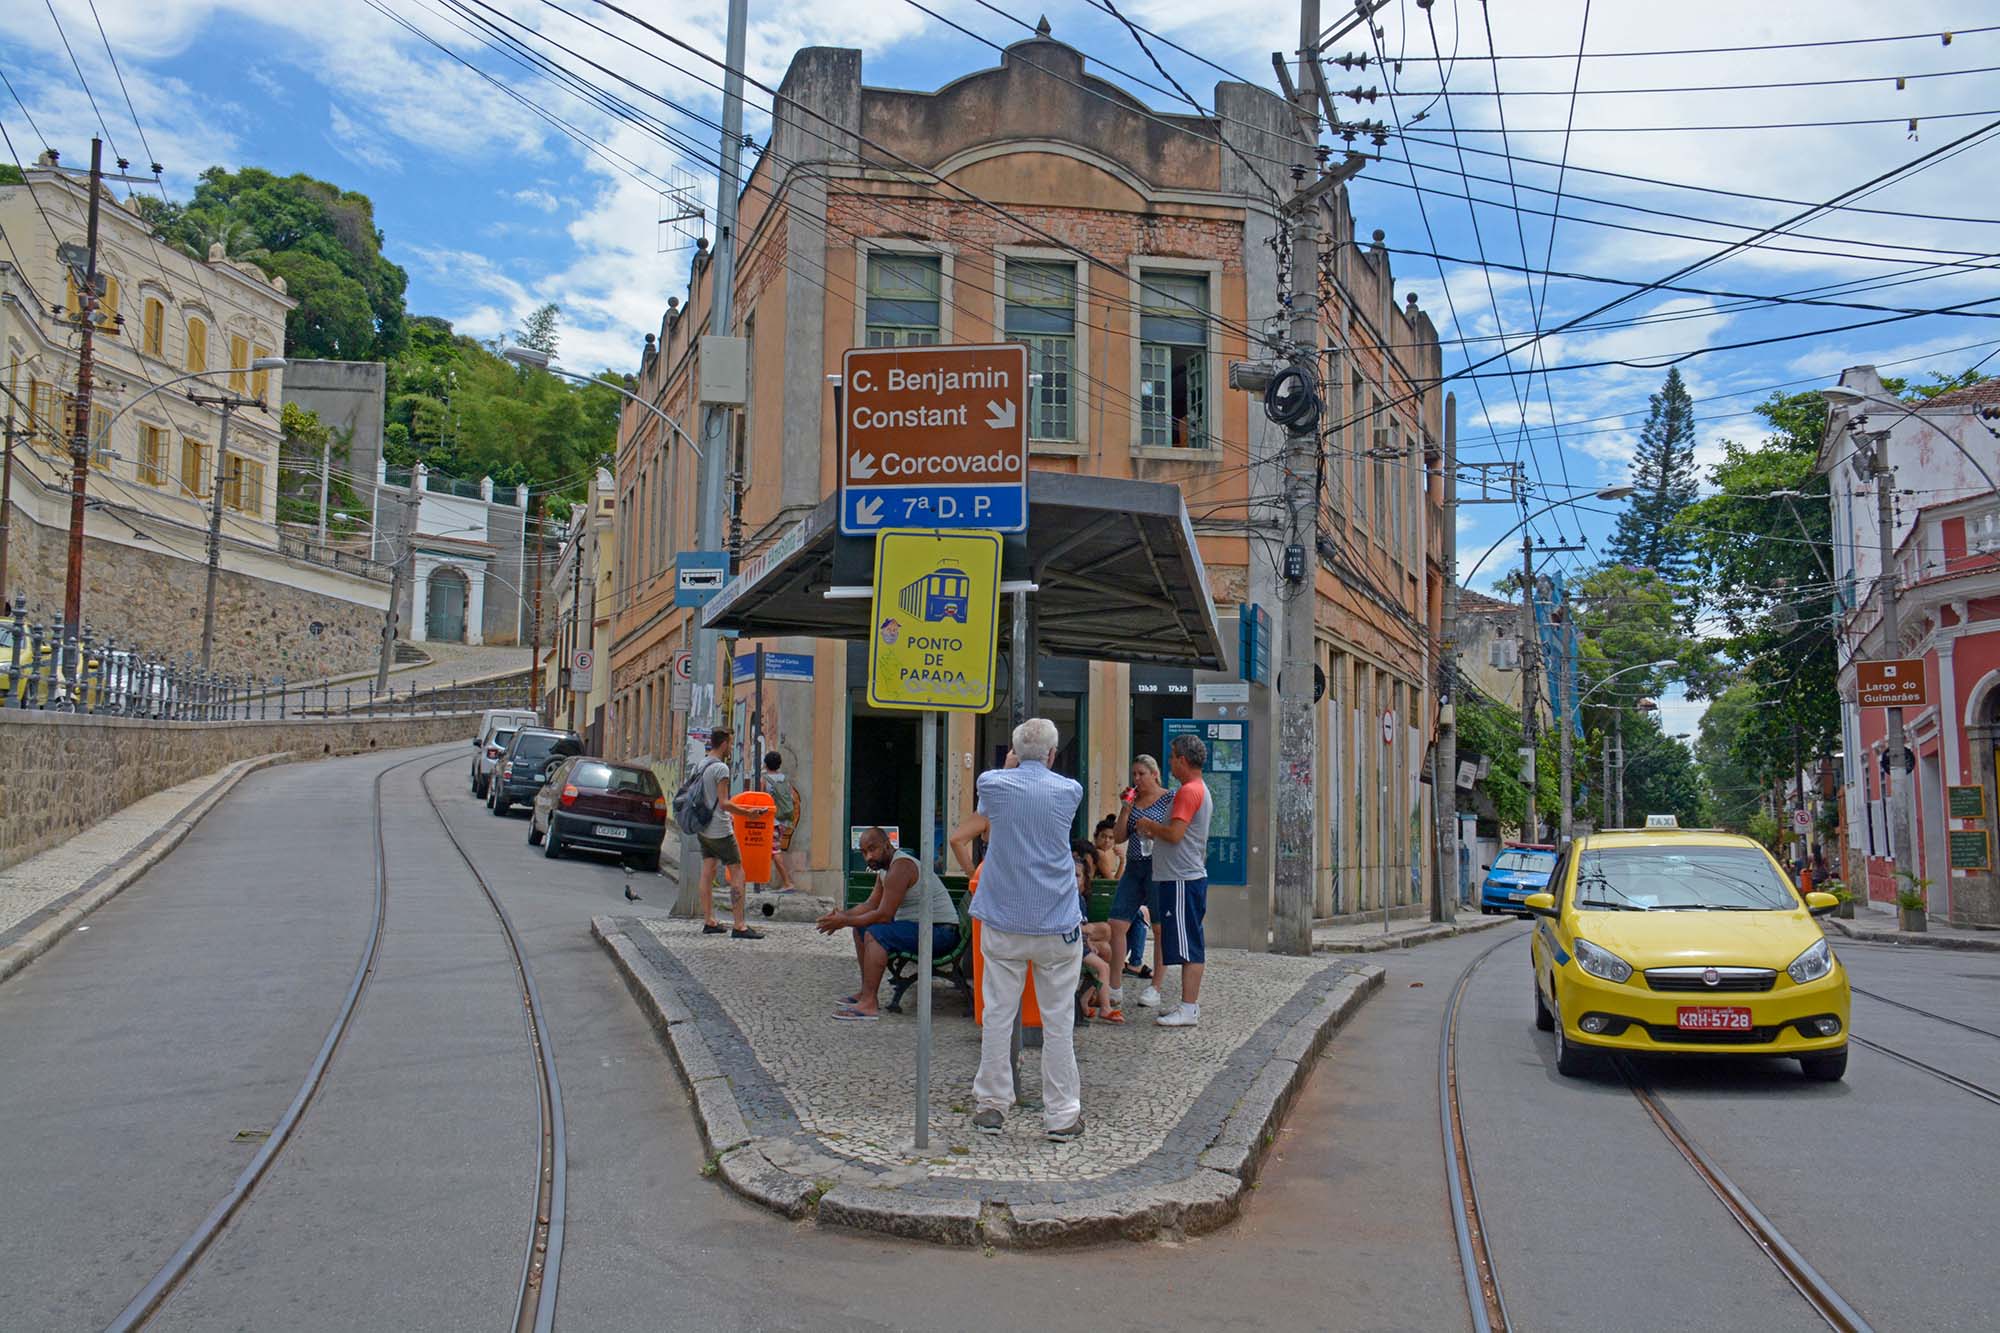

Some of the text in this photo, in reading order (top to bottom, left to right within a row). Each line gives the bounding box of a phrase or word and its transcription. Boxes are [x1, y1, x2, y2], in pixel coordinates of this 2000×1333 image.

[852, 367, 1008, 395] C. Benjamin
[852, 404, 968, 429] Constant
[881, 449, 1020, 476] Corcovado
[938, 496, 964, 518] D.
[974, 495, 992, 518] P.
[907, 636, 963, 651] PONTO
[579, 656, 587, 666] E
[924, 653, 944, 667] DE
[900, 668, 967, 684] PARADA
[1865, 680, 1917, 692] Largo do
[1863, 692, 1921, 703] Guimarães
[1648, 817, 1675, 826] TAXI
